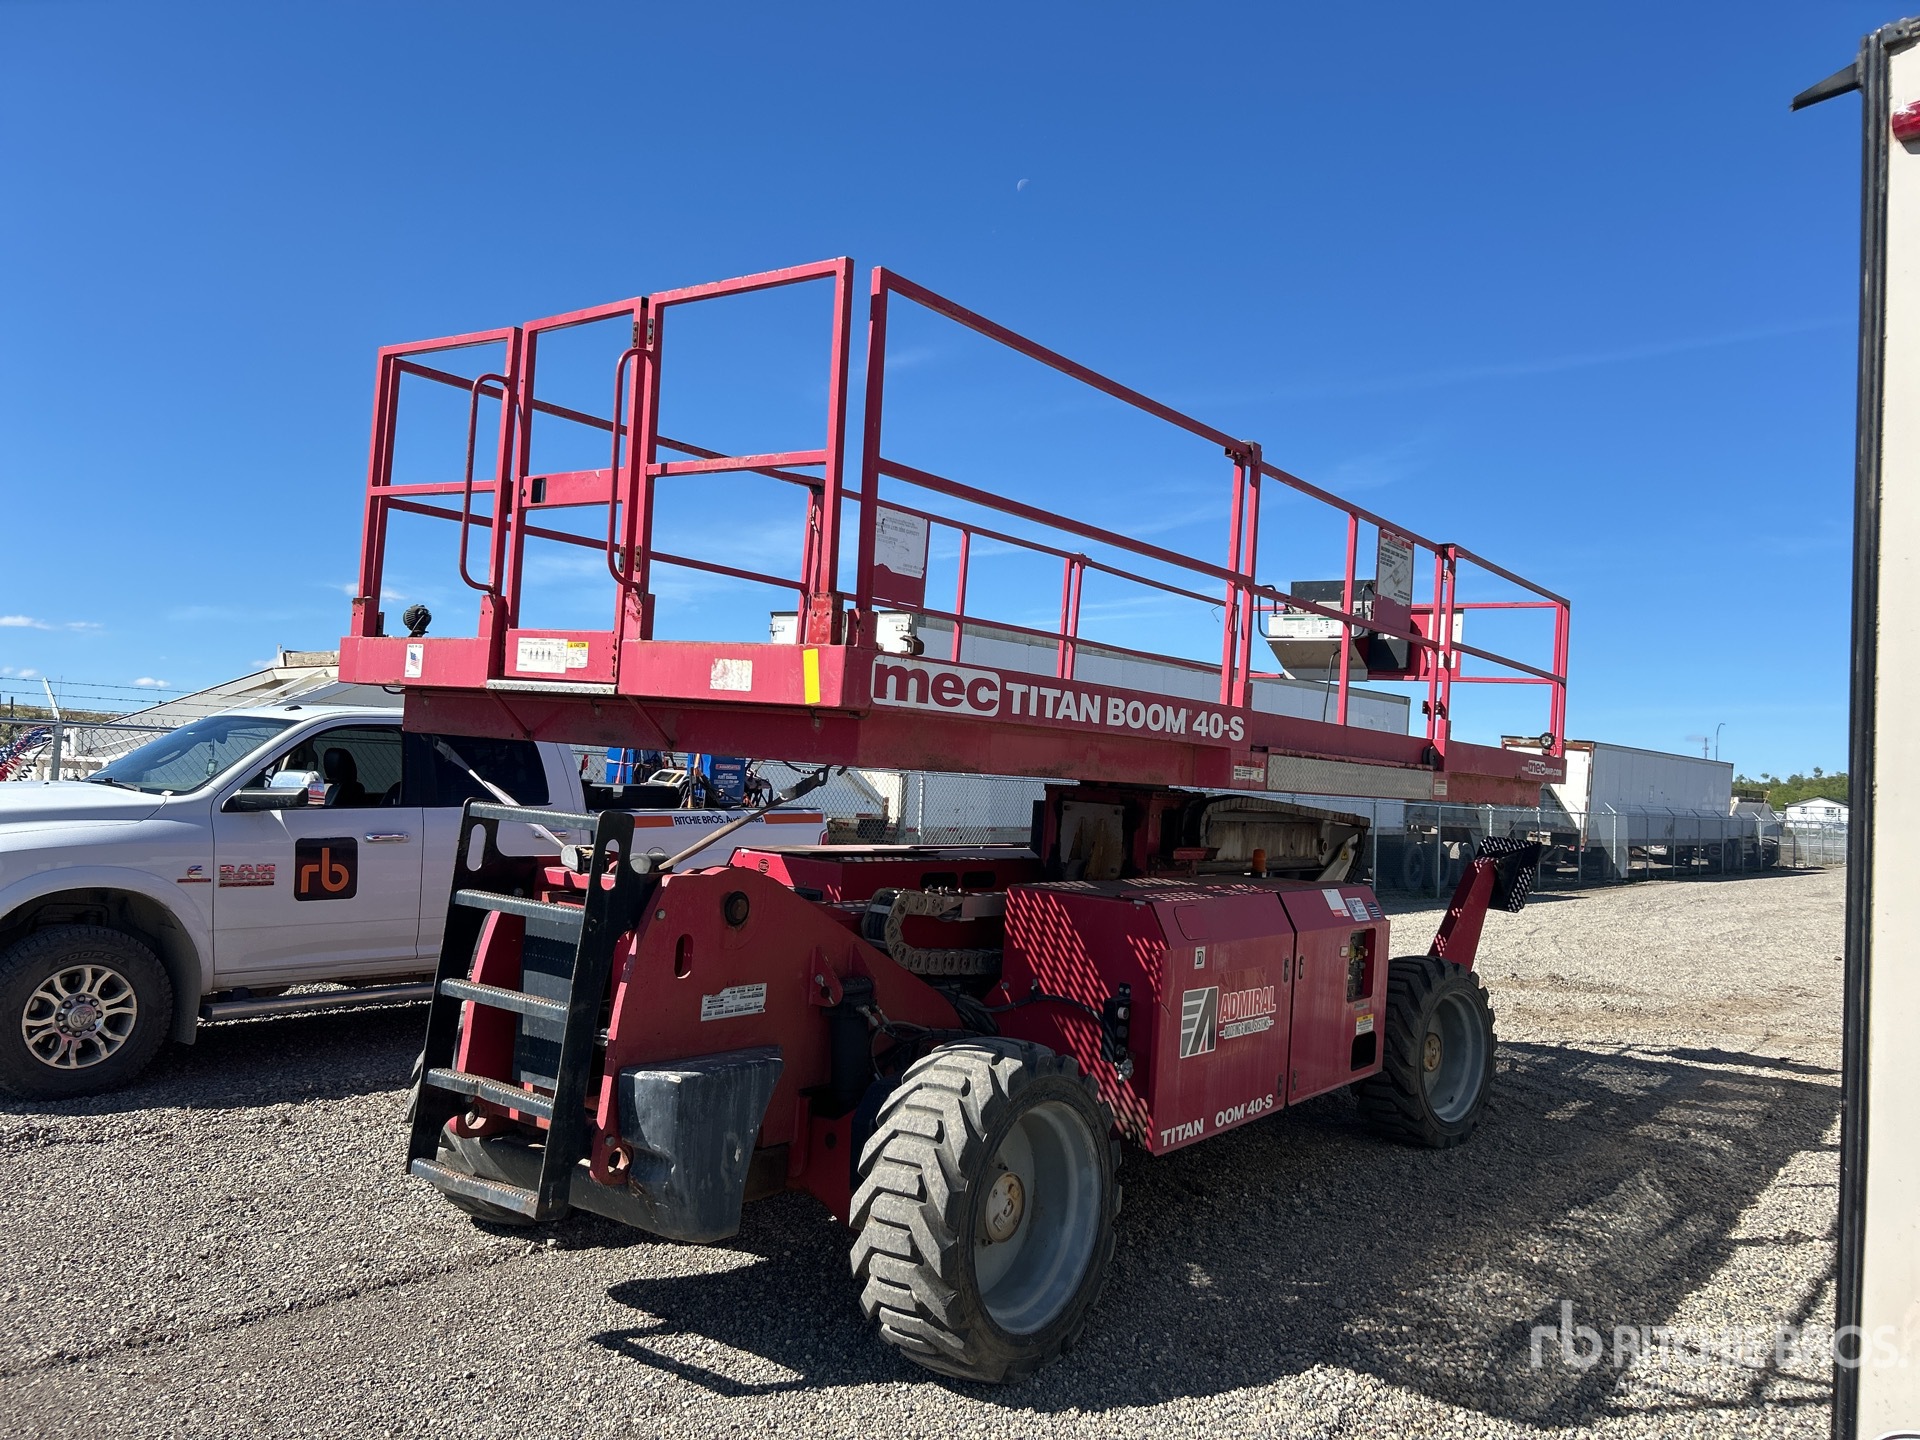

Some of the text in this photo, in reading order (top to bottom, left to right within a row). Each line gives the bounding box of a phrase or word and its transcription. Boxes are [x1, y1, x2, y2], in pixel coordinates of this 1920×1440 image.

[873, 662, 998, 713] mec
[1006, 682, 1101, 724] TITAN
[1192, 710, 1245, 741] 40-S
[674, 816, 701, 826] RITCHIE
[219, 864, 276, 873] RAM
[300, 847, 350, 893] rb
[57, 951, 125, 964] COOPER
[1219, 985, 1277, 1024] ADMIRAL
[1160, 1117, 1205, 1147] TITAN
[1247, 1093, 1274, 1115] 40-S
